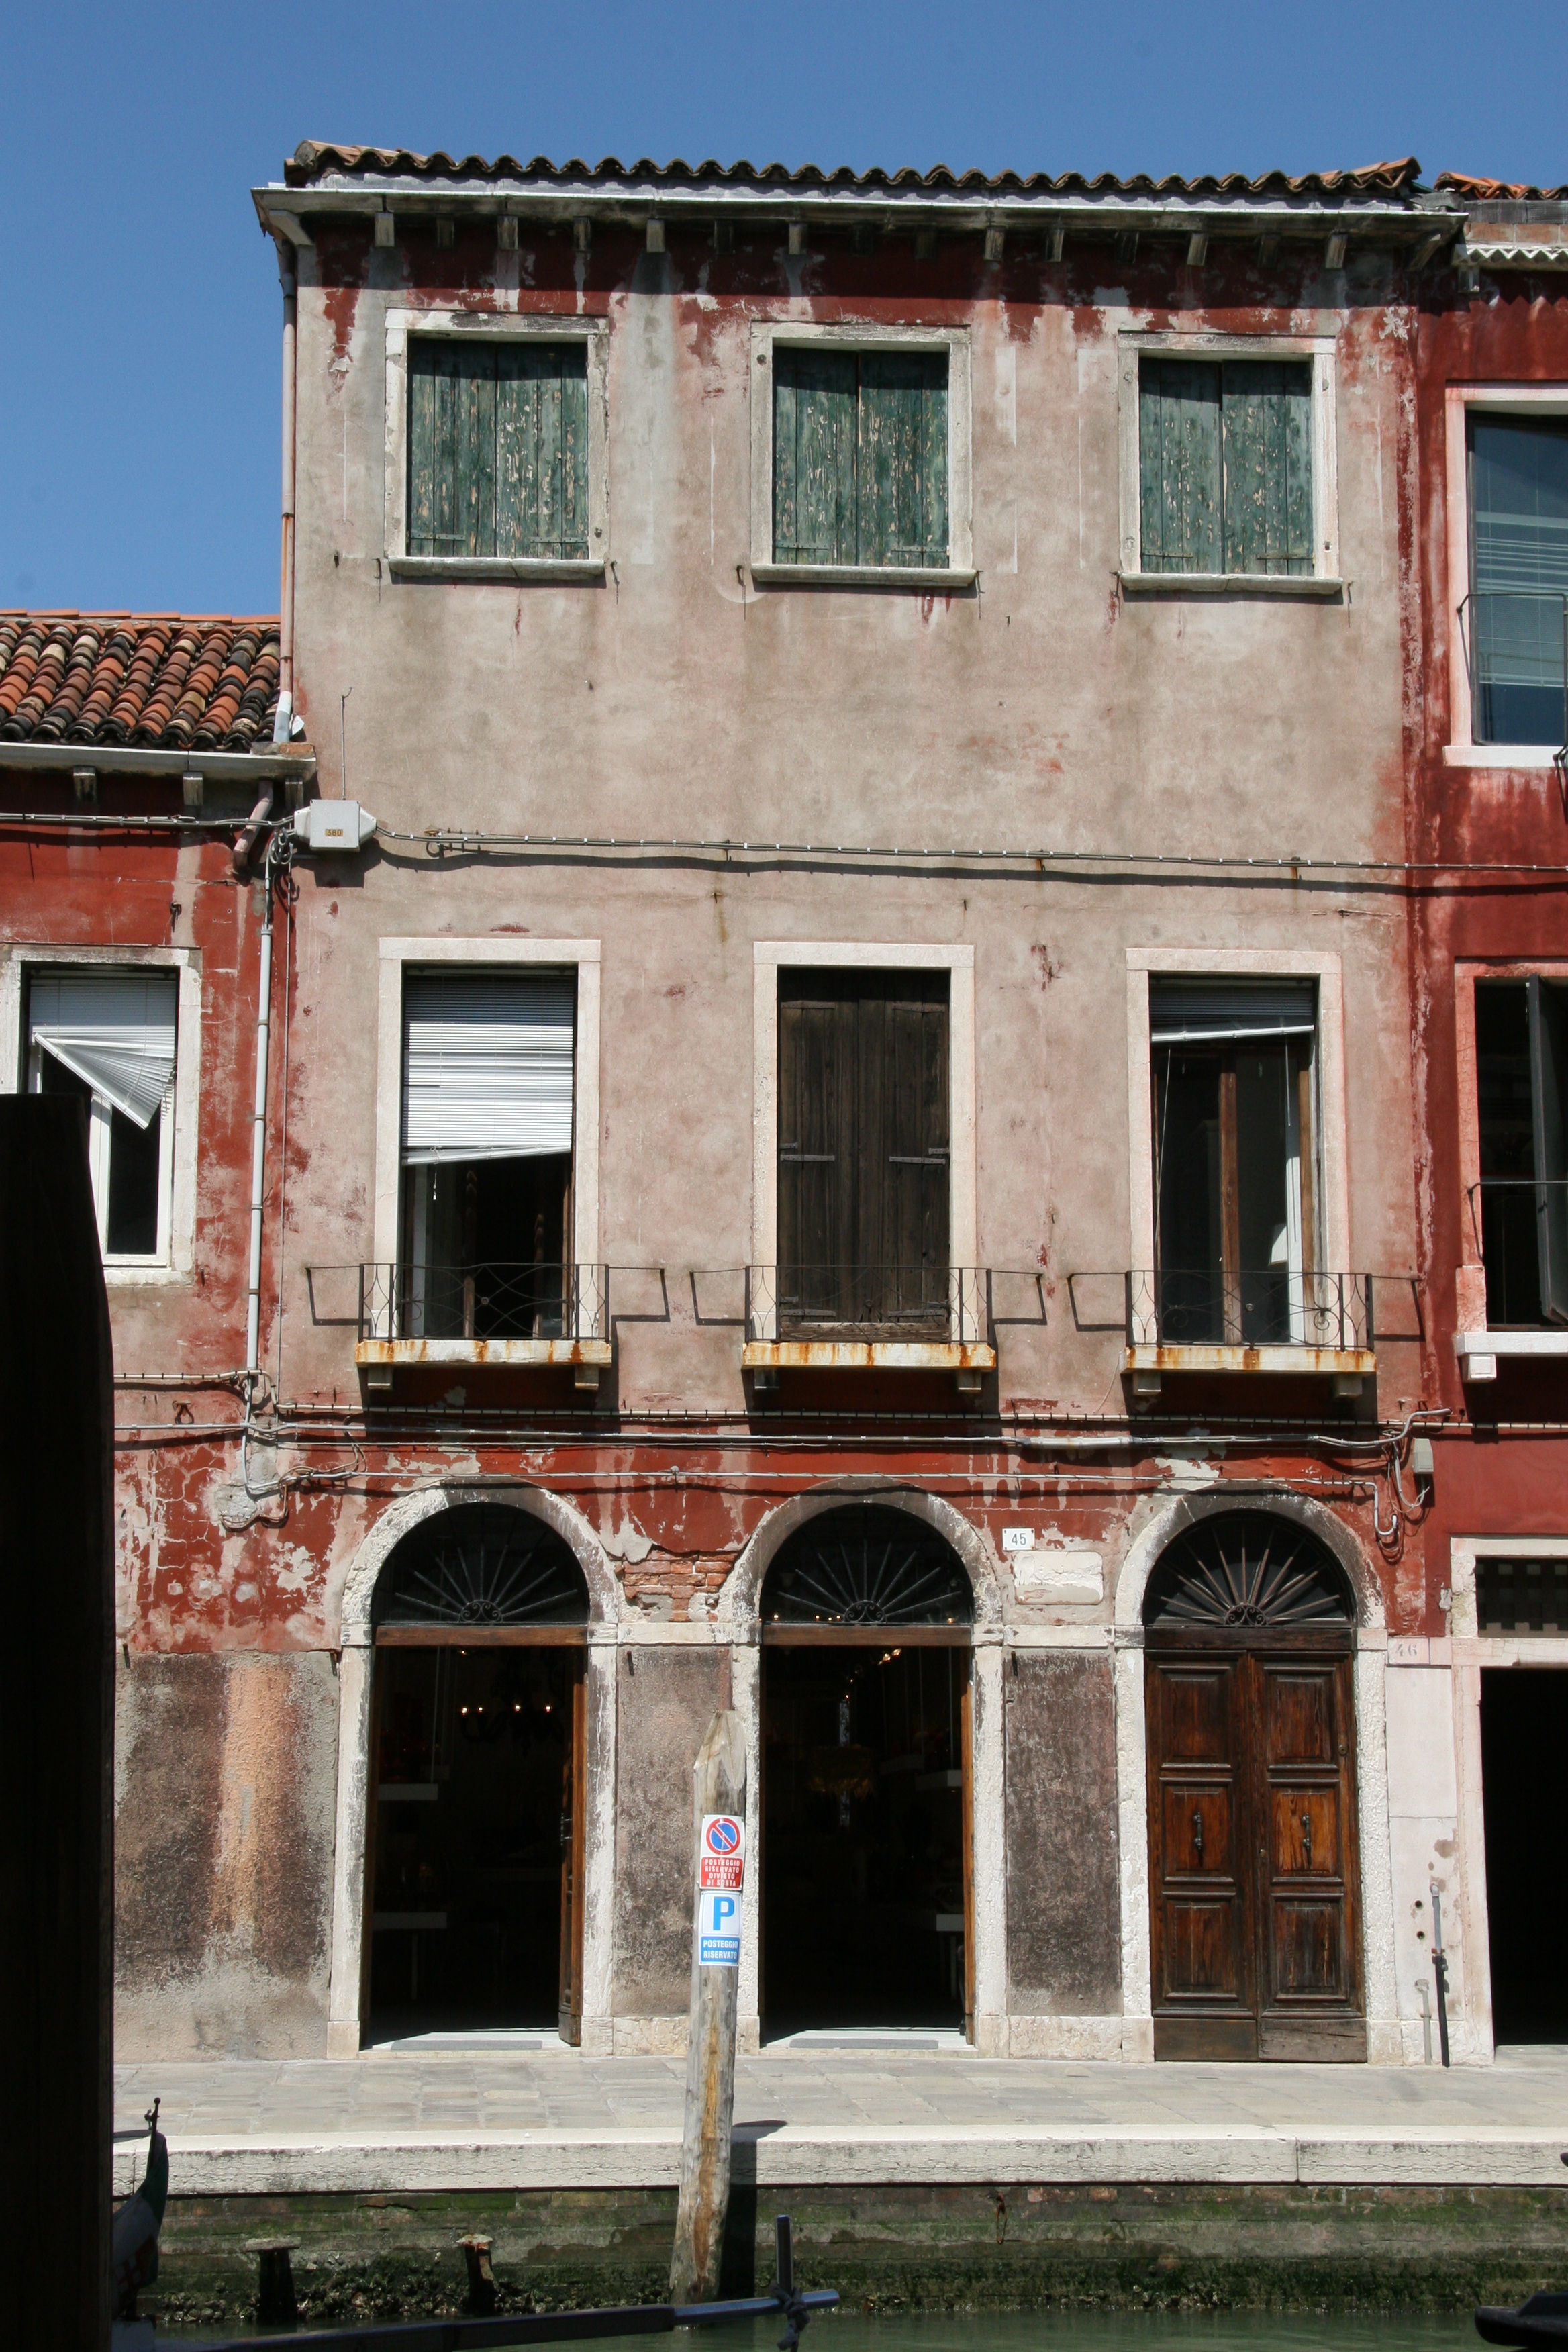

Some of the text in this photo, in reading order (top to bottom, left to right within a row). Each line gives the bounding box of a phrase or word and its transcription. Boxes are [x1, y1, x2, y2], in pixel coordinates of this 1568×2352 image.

[1011, 1532, 1026, 1546] 45
[1395, 1643, 1418, 1657] 46
[705, 1859, 740, 1867] POSTEGGIO
[705, 1865, 740, 1873] RISERVATO
[713, 1896, 735, 1931] P
[703, 1939, 738, 1949] POSTEGGIO
[703, 1950, 738, 1959] RISERVATO
